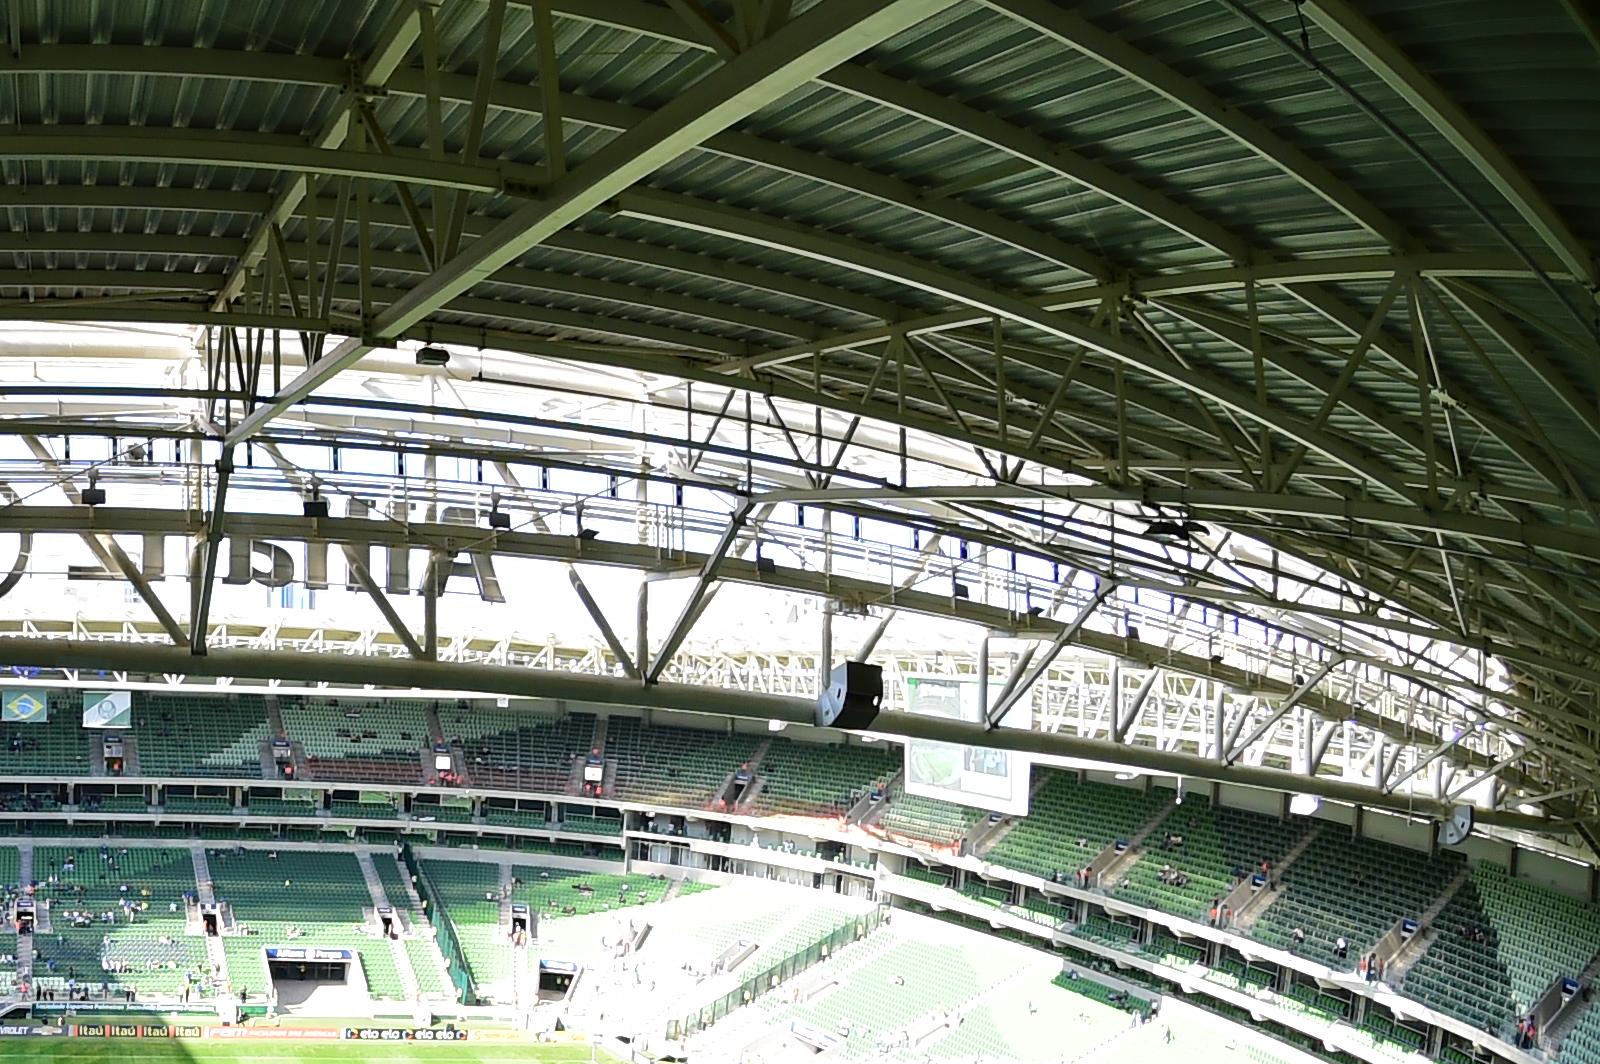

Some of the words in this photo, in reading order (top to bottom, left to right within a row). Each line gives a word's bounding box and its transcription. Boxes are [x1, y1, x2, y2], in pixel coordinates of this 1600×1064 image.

[79, 1025, 104, 1037] Itaú
[111, 1025, 136, 1037] Itaú
[143, 1025, 168, 1037] Itaú
[176, 1025, 200, 1037] Itaú
